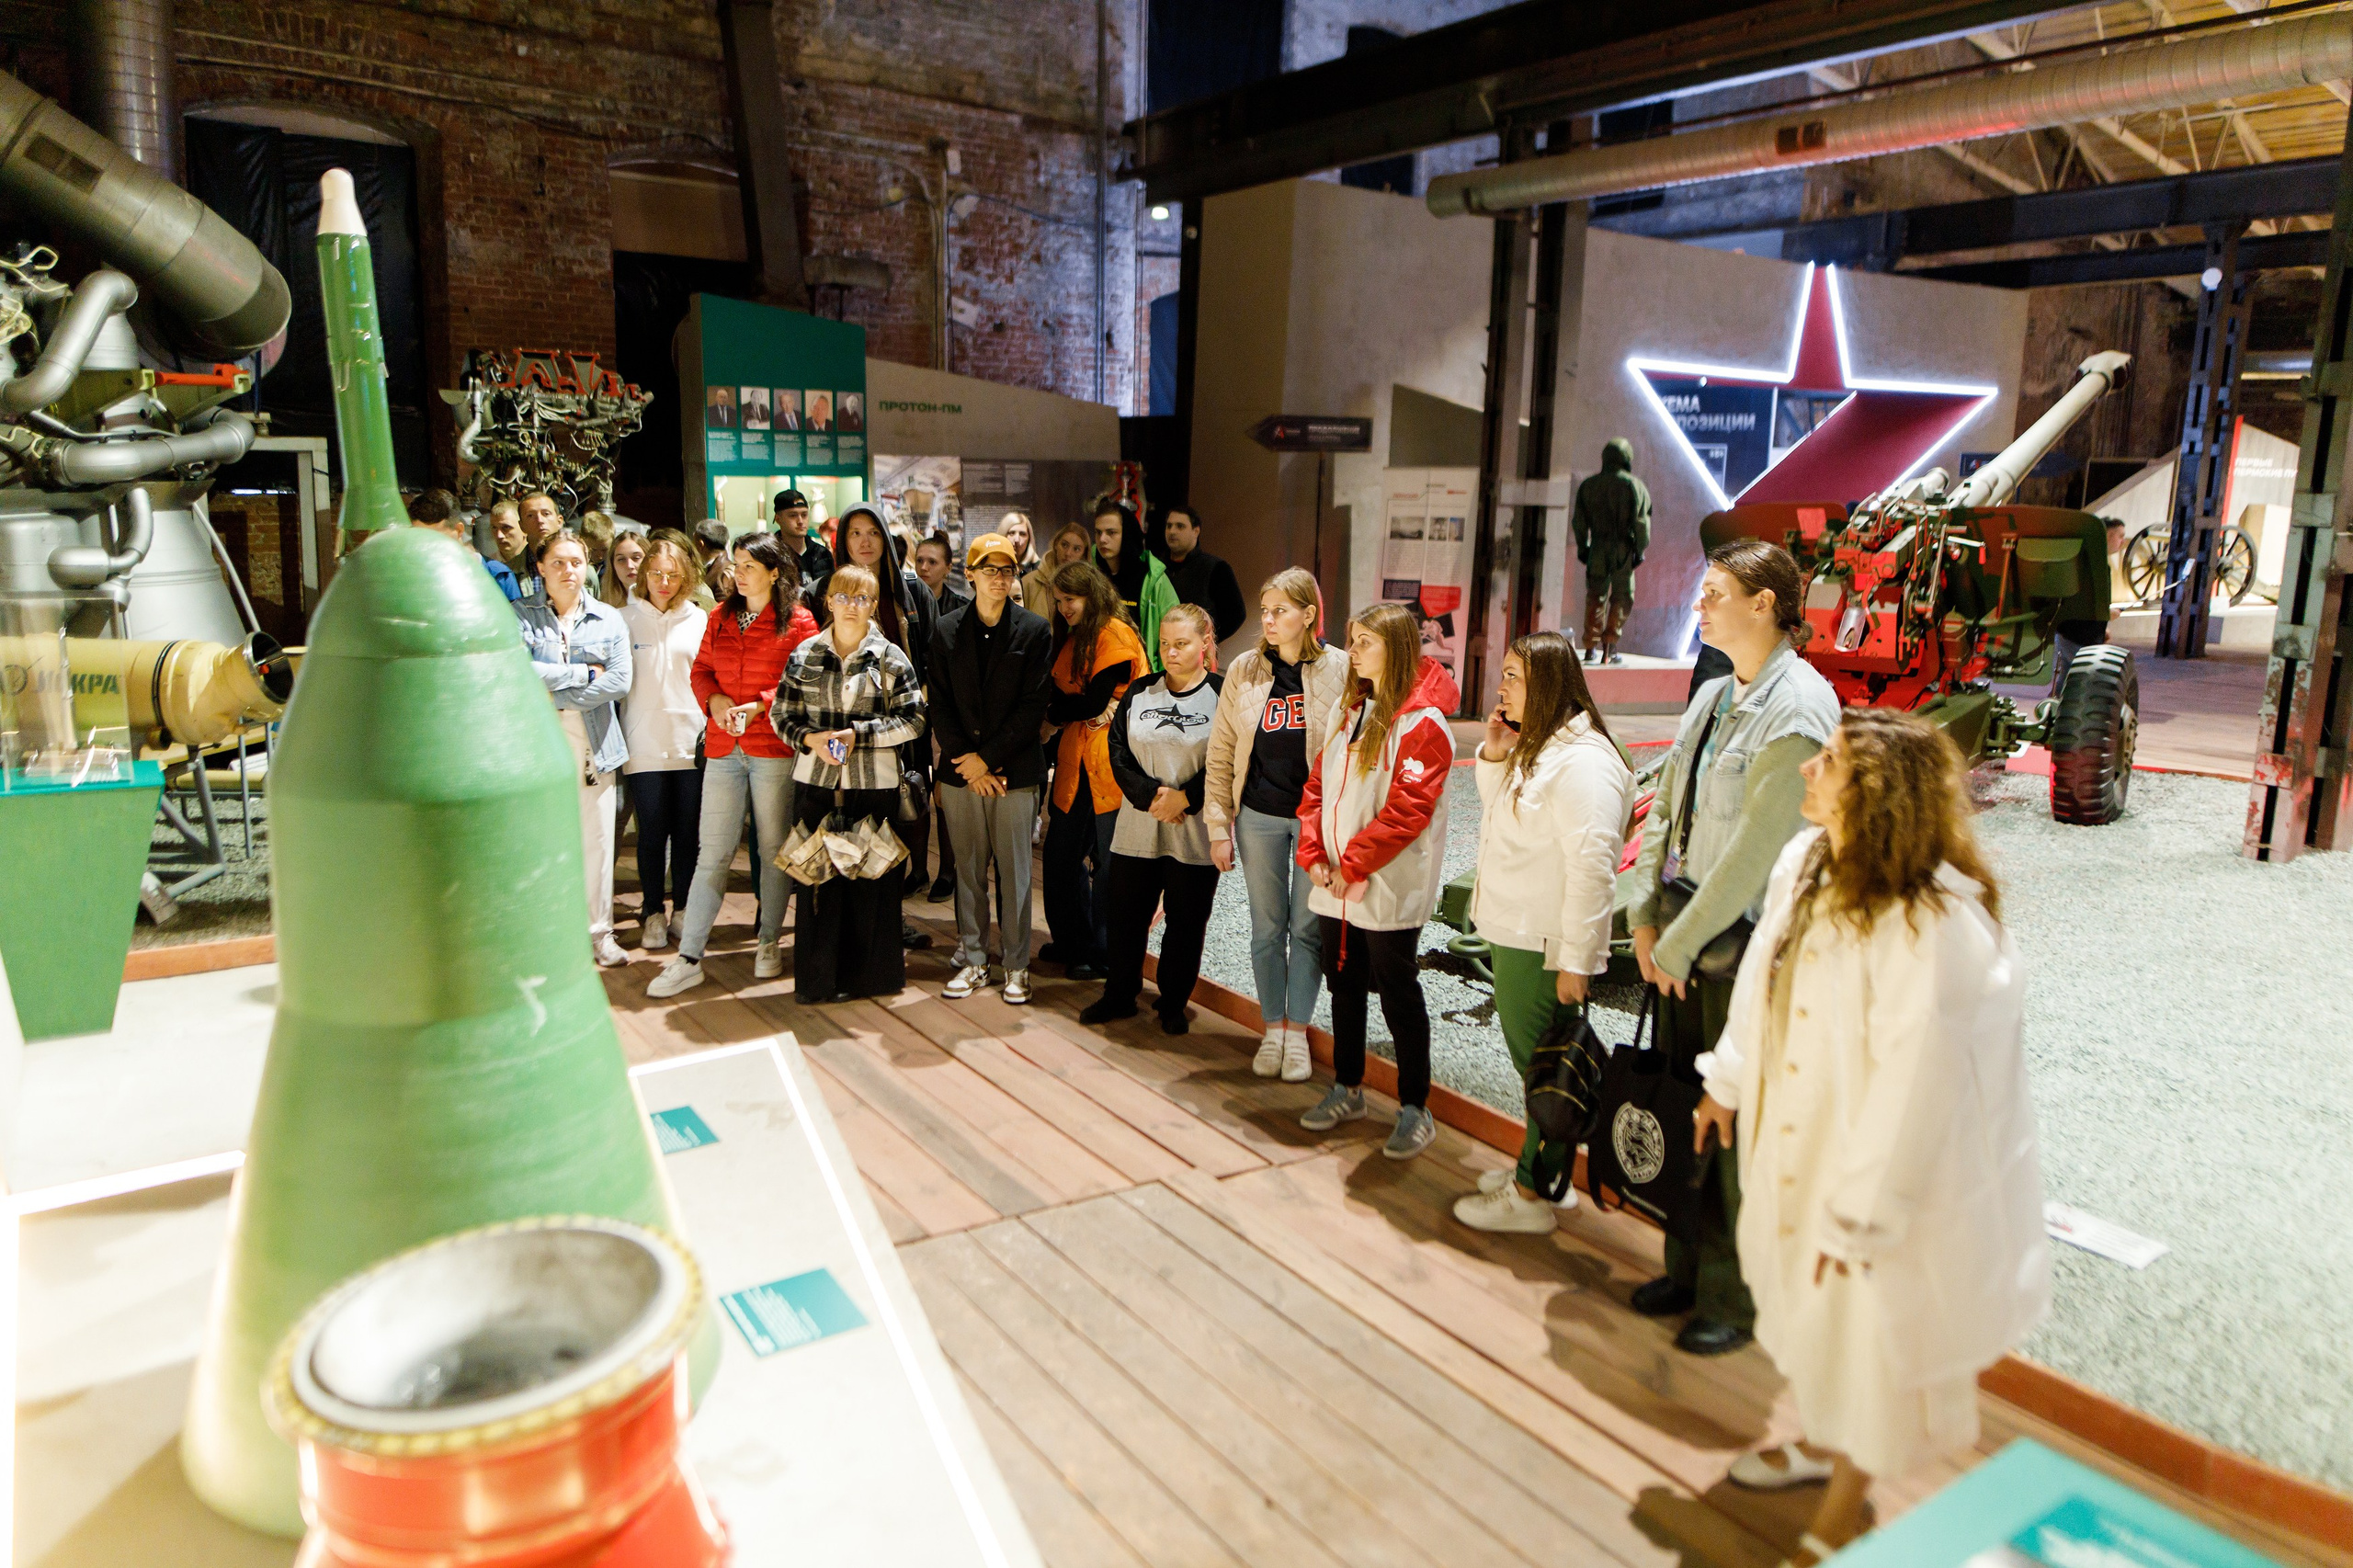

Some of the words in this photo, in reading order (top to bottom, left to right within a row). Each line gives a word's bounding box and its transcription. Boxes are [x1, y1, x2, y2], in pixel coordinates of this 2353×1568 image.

[879, 400, 962, 414] ПРОТОН-ПМ
[2234, 457, 2274, 468] ПЕРВЫЕ
[2233, 467, 2284, 479] ПЕРМСКИЕ
